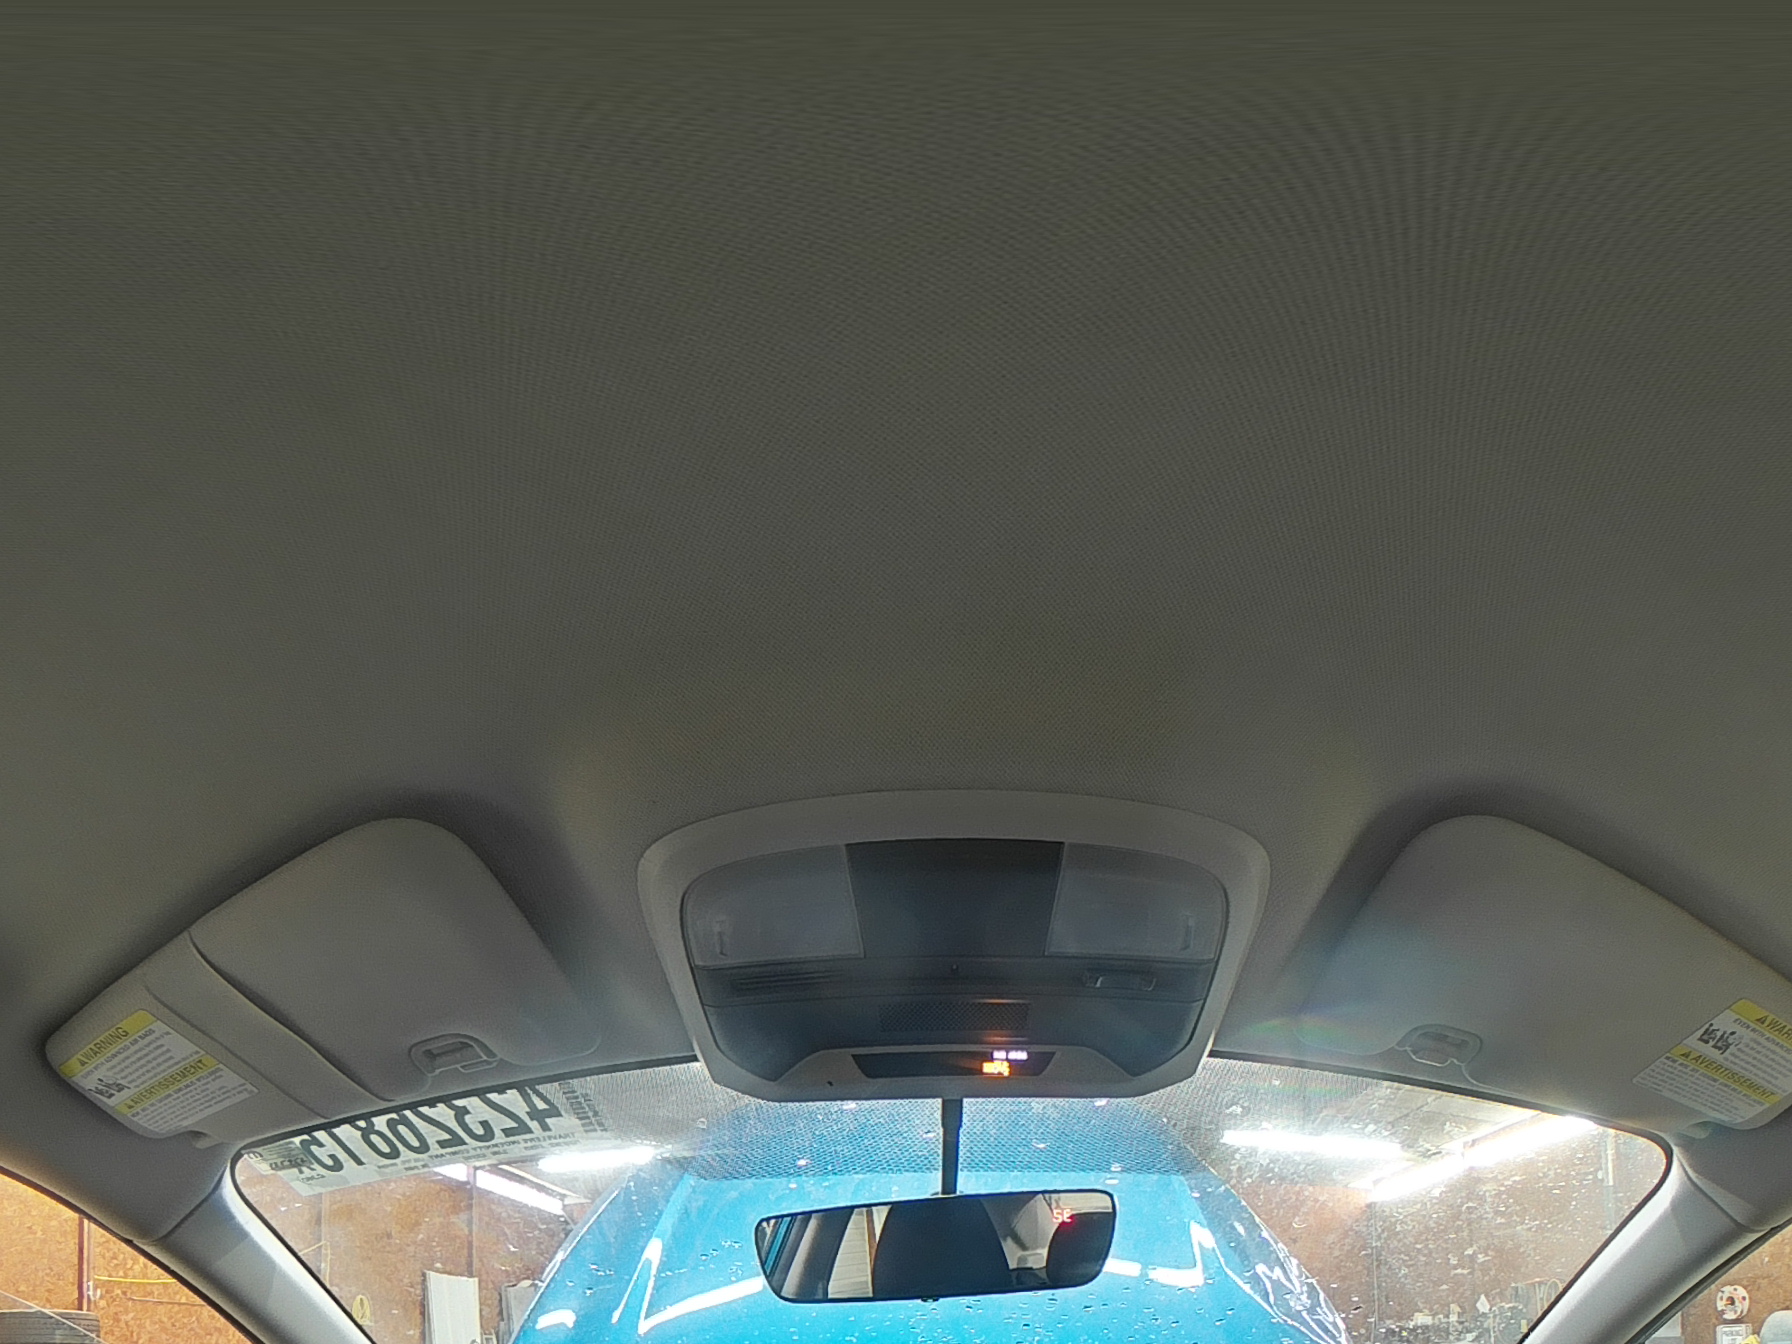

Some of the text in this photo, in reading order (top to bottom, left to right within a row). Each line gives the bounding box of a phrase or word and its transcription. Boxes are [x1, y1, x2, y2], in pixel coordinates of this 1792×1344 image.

[81, 1026, 130, 1063] WARNING
[131, 1059, 209, 1107] AVERTISSEMENT
[1691, 1054, 1776, 1100] AVERTISSEMENT
[1053, 1208, 1072, 1222] SE
